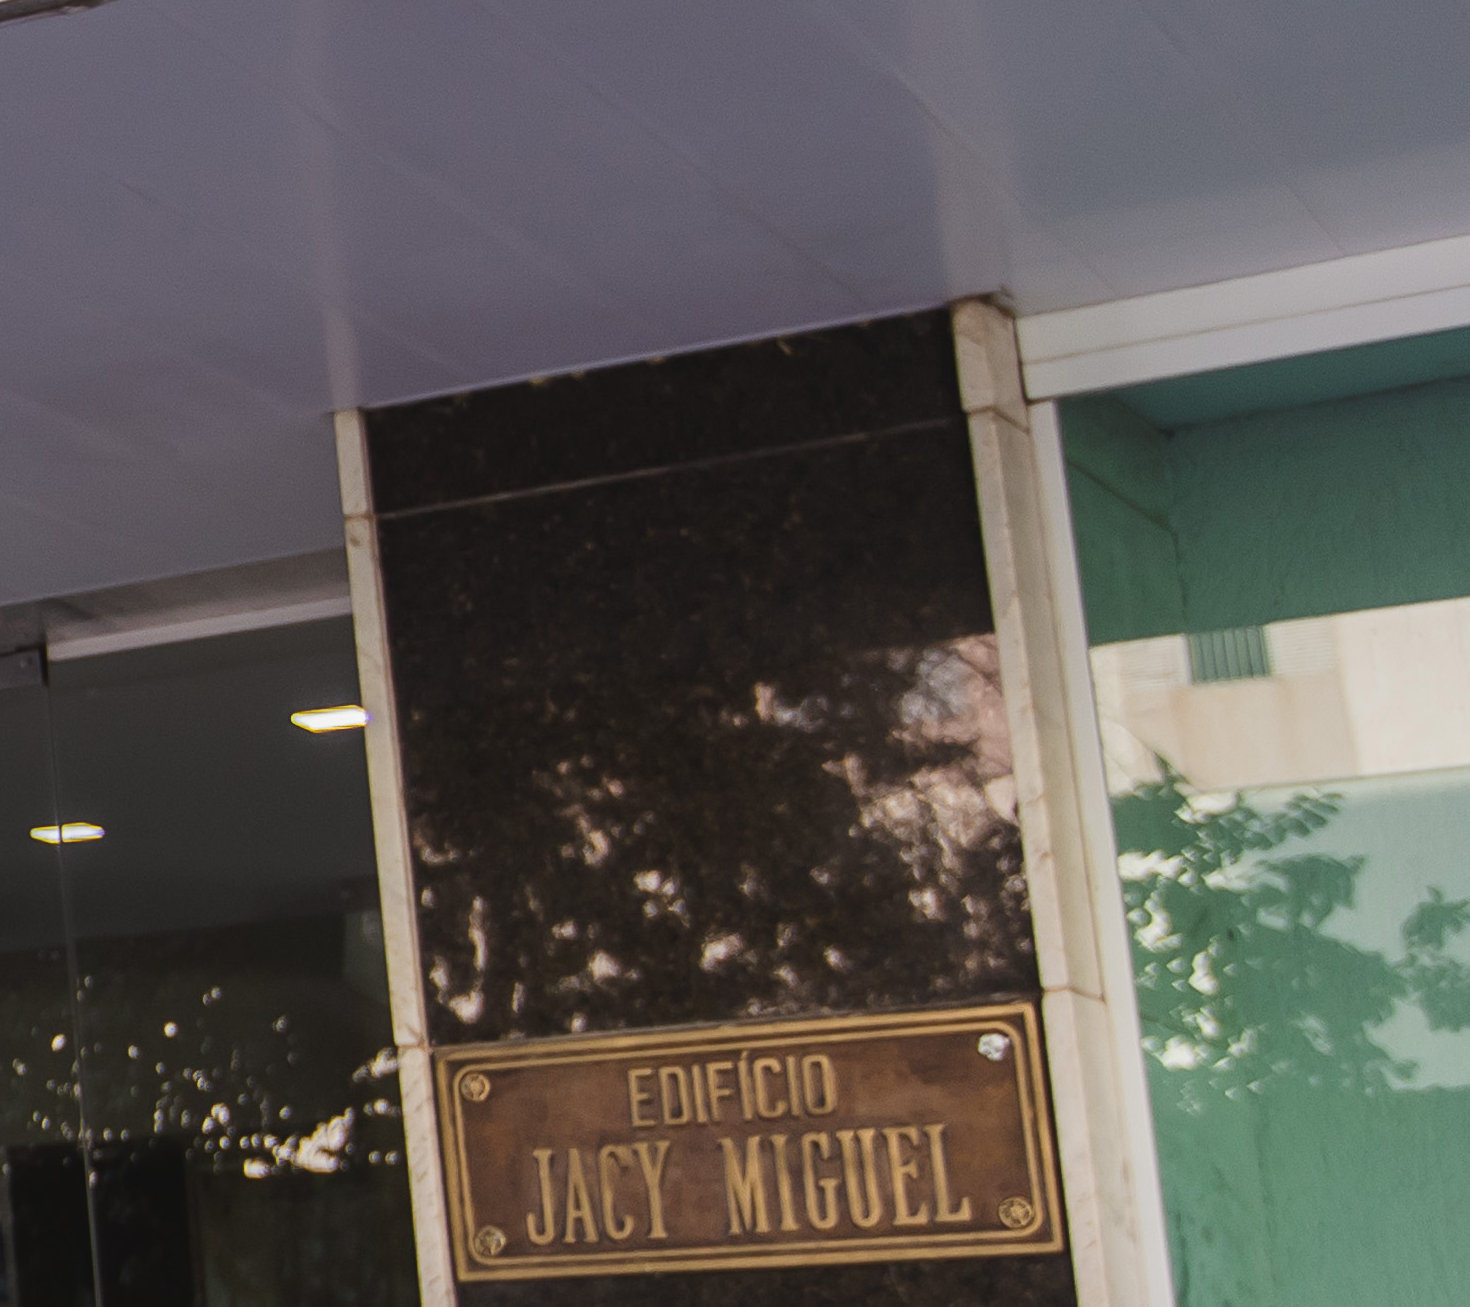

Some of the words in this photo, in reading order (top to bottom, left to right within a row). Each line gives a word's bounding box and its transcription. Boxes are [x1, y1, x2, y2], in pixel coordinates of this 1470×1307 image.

[626, 1050, 840, 1128] EDIFÍCIO
[525, 1139, 672, 1248] JACY
[718, 1122, 972, 1238] MIGUEL
